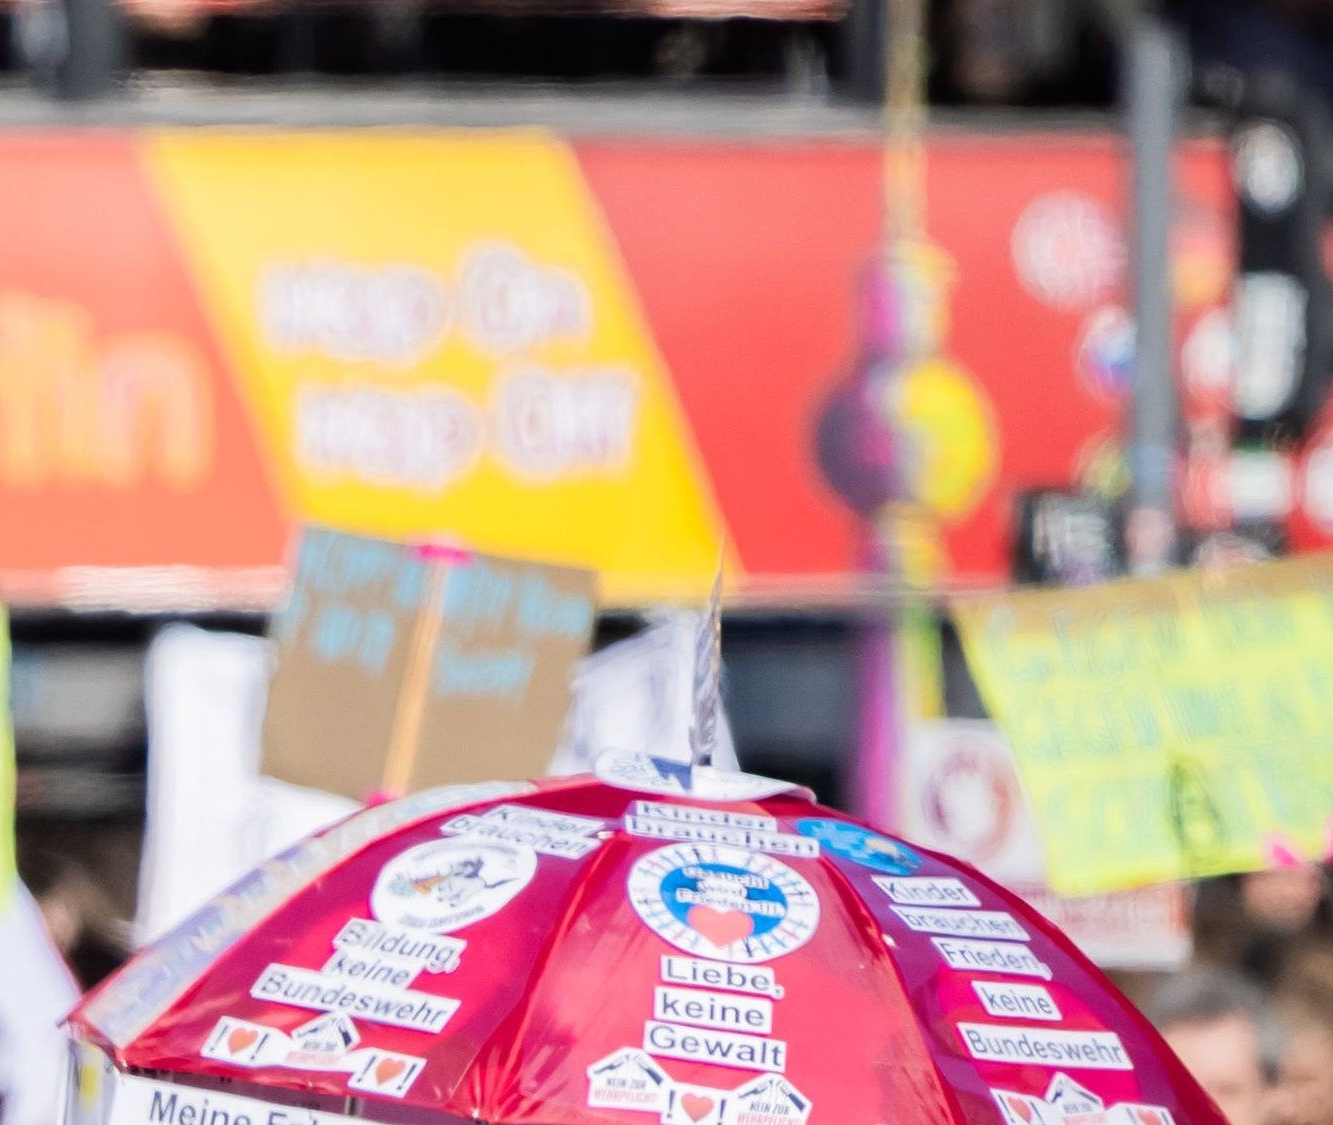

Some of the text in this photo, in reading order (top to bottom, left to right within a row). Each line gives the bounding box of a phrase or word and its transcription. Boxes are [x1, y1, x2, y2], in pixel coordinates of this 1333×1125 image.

[882, 880, 972, 901] Kinder
[902, 908, 1025, 938] brauchen
[334, 954, 409, 986] keine
[665, 958, 782, 996] Liebe,
[260, 973, 447, 1025] Bundeswehr
[662, 992, 765, 1027] keine
[982, 987, 1053, 1014] keine
[649, 1025, 783, 1067] Gewalt
[965, 1029, 1123, 1064] Bundeswehr
